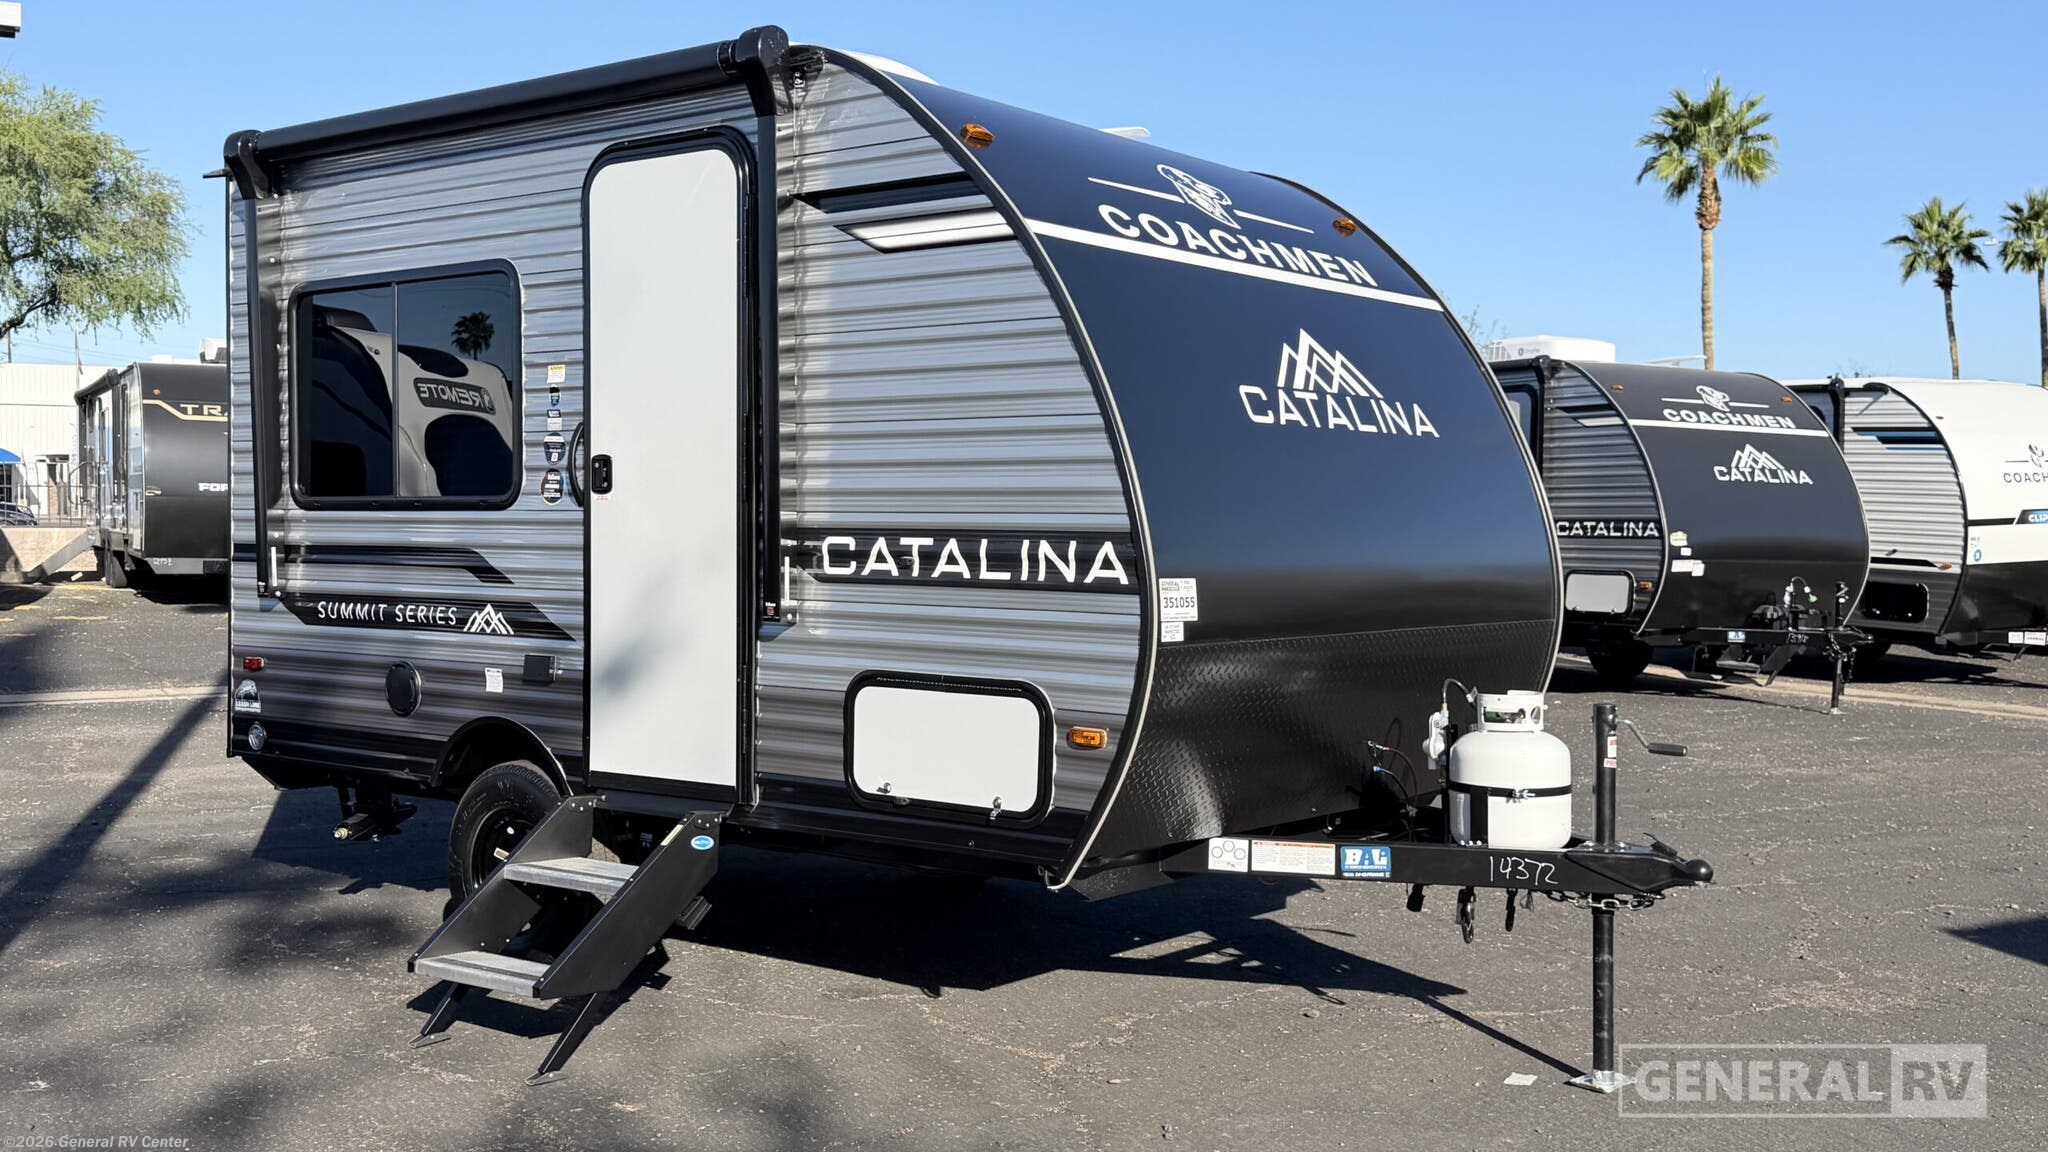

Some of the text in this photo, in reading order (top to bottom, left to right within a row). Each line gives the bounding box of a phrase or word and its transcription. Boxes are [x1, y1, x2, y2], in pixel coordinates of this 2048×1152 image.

[1097, 203, 1379, 287] COACHMEN
[179, 403, 228, 416] TR
[1238, 384, 1440, 439] CATALINA
[1662, 408, 1797, 429] COACHMEN
[1713, 465, 1814, 485] CATALINA
[1556, 521, 1659, 537] CATALINA
[821, 535, 1130, 585] CATALINA
[316, 600, 458, 626] SUMMIT SERIES
[1163, 597, 1195, 608] 351055
[1344, 848, 1388, 866] BAL
[1489, 855, 1559, 886] 14372
